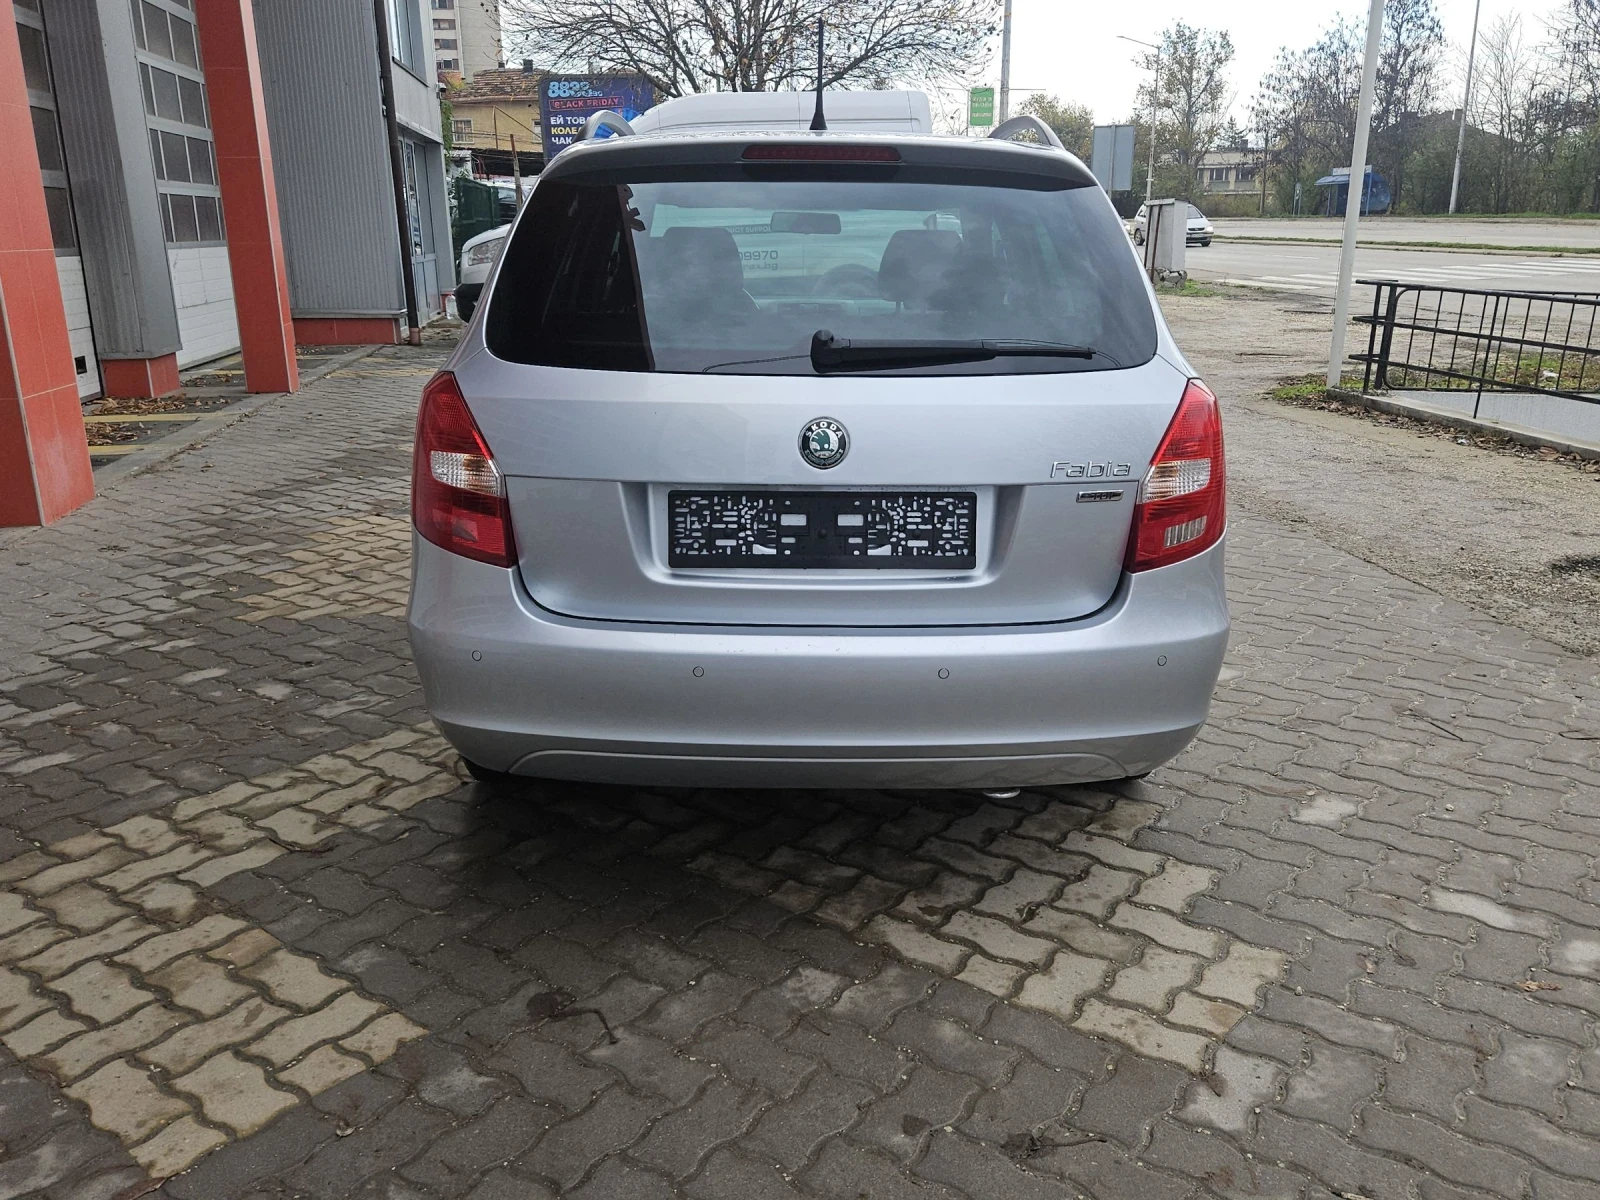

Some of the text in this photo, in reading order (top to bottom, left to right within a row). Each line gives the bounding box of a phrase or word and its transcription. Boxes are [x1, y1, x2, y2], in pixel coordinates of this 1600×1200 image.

[587, 97, 619, 107] FRIDAY
[550, 114, 589, 125] ЕЙ ТОВ
[551, 126, 581, 135] КОЛЕ
[551, 136, 573, 145] ЧАК
[1050, 460, 1131, 478] Fabia
